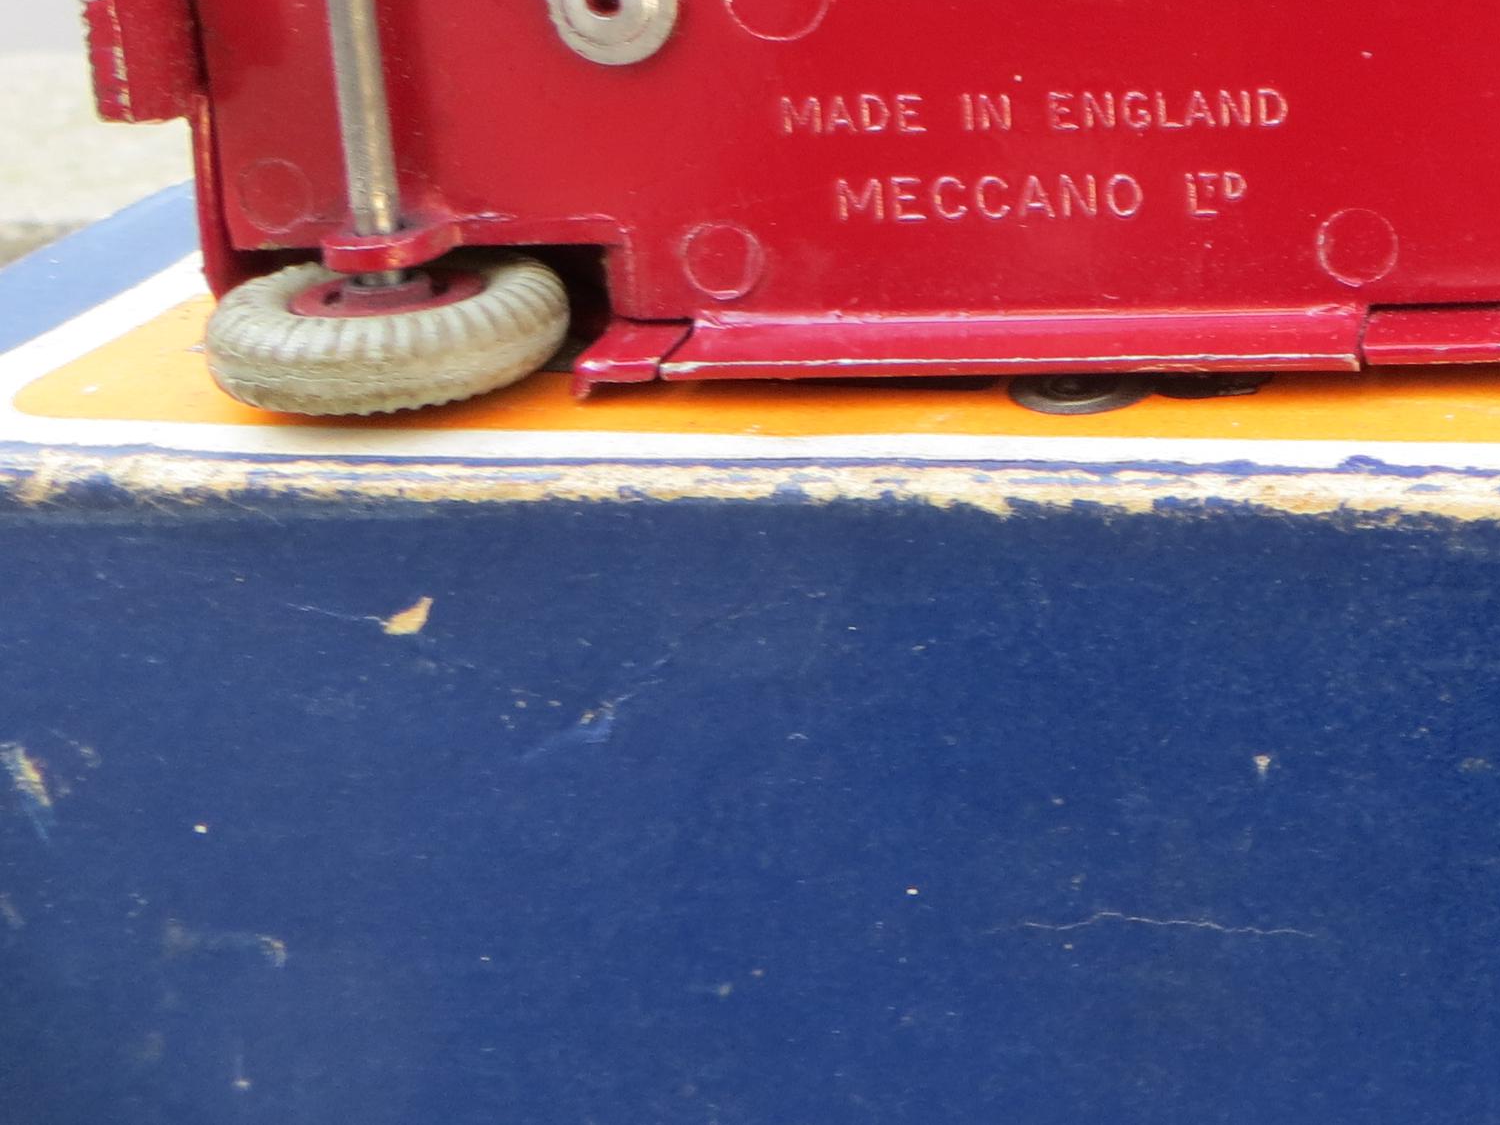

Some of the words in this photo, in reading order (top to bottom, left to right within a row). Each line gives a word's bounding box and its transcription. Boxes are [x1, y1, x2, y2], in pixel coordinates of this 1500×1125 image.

[780, 94, 927, 135] MADE
[961, 93, 1014, 132] IN
[1050, 88, 1290, 131] ENGLAND
[836, 173, 1145, 221] MECCANO
